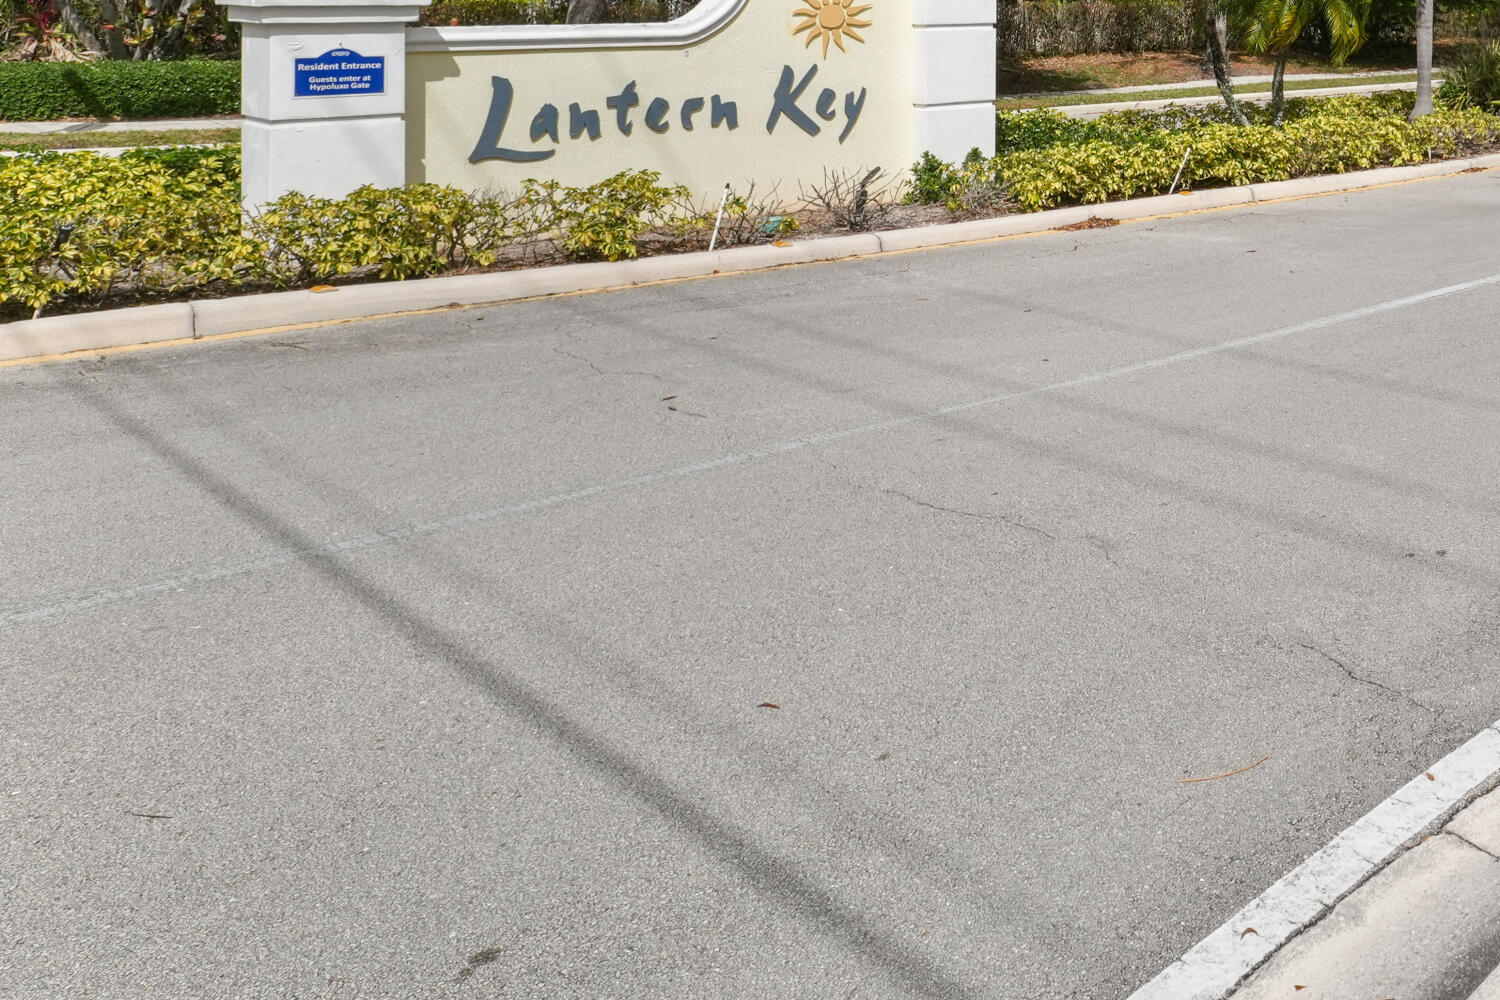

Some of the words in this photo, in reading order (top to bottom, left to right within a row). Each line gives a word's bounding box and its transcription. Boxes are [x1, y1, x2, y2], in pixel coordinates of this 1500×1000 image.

[297, 63, 340, 71] Resident
[341, 62, 382, 70] Entrance
[309, 83, 350, 92] Hypoluxo
[469, 75, 740, 164] Lantern
[766, 64, 866, 145] Key
